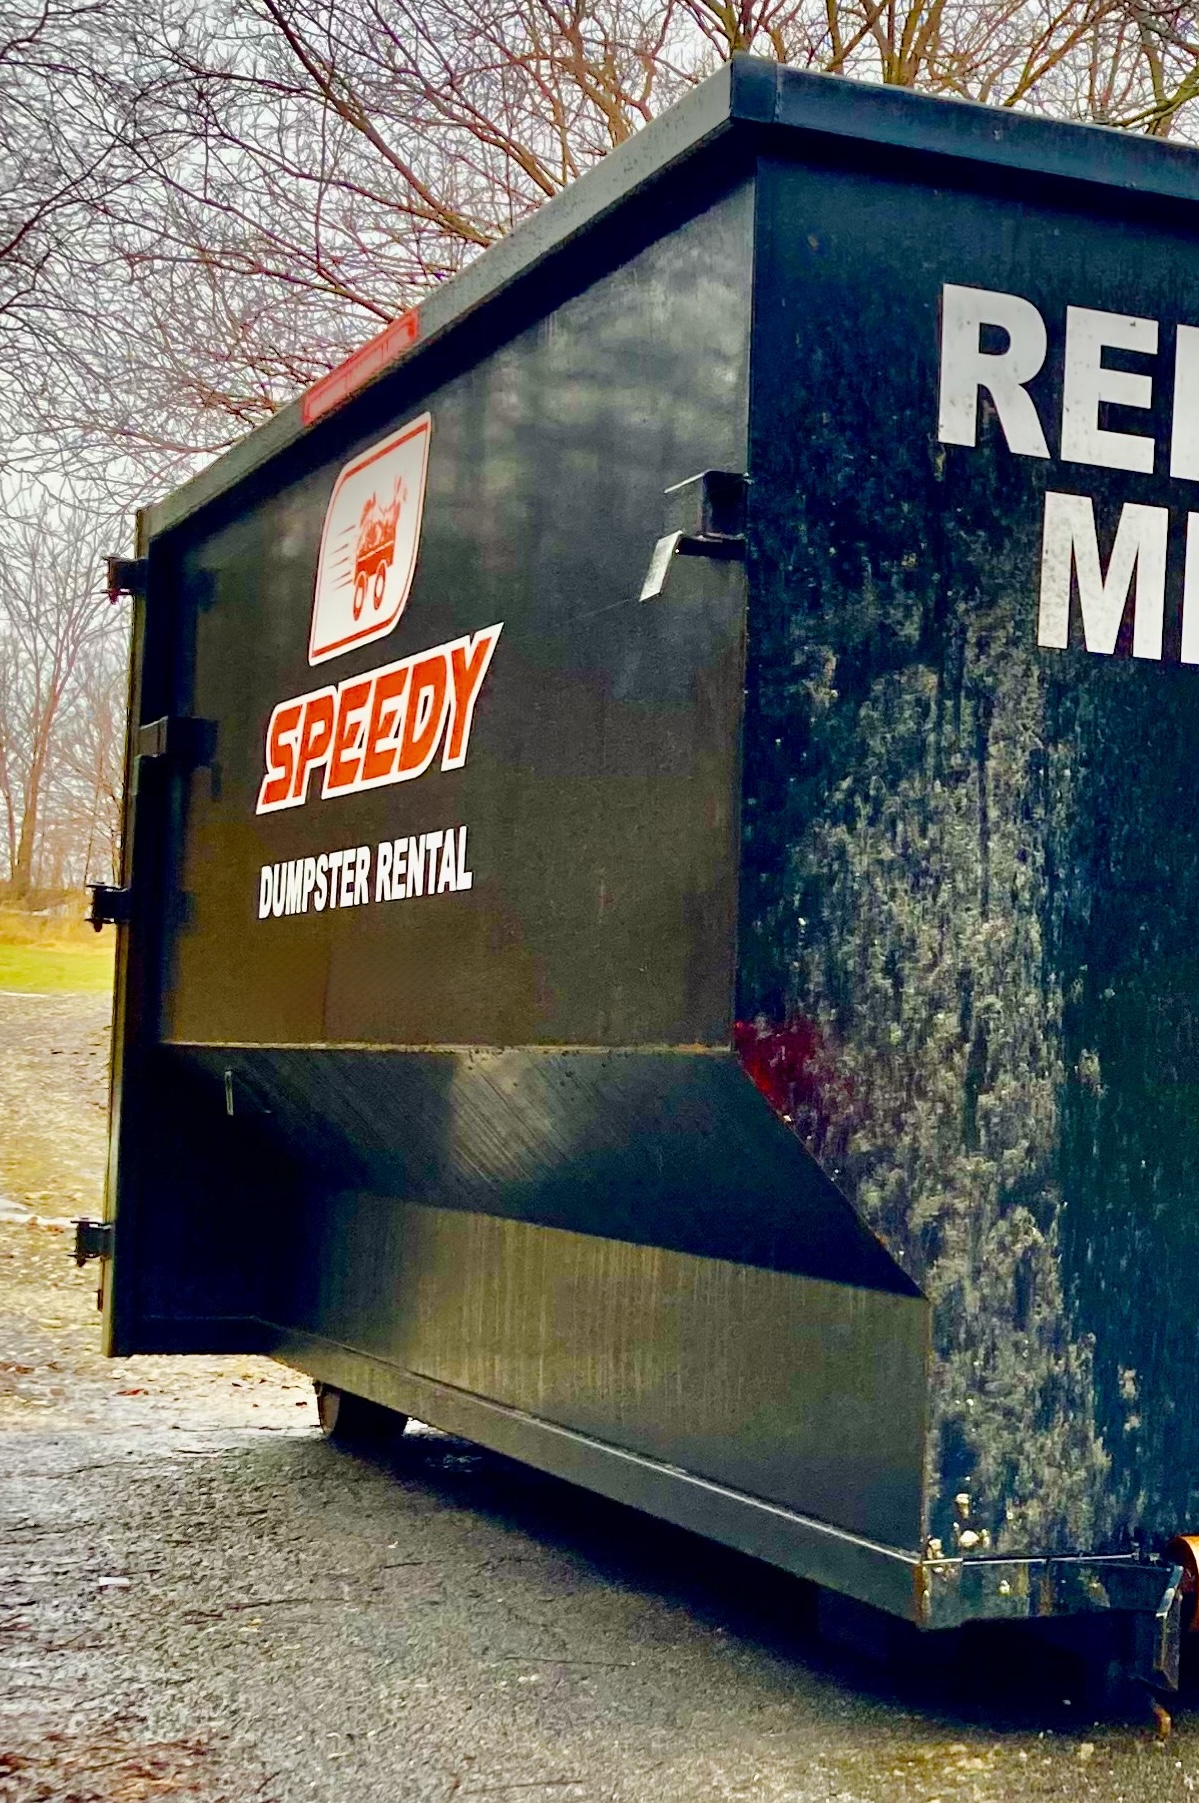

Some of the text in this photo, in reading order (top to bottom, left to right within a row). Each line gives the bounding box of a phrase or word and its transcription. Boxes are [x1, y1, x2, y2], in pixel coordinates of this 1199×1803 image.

[256, 622, 504, 815] SPEEDY
[258, 826, 473, 920] DUMPSTER RENTAL
